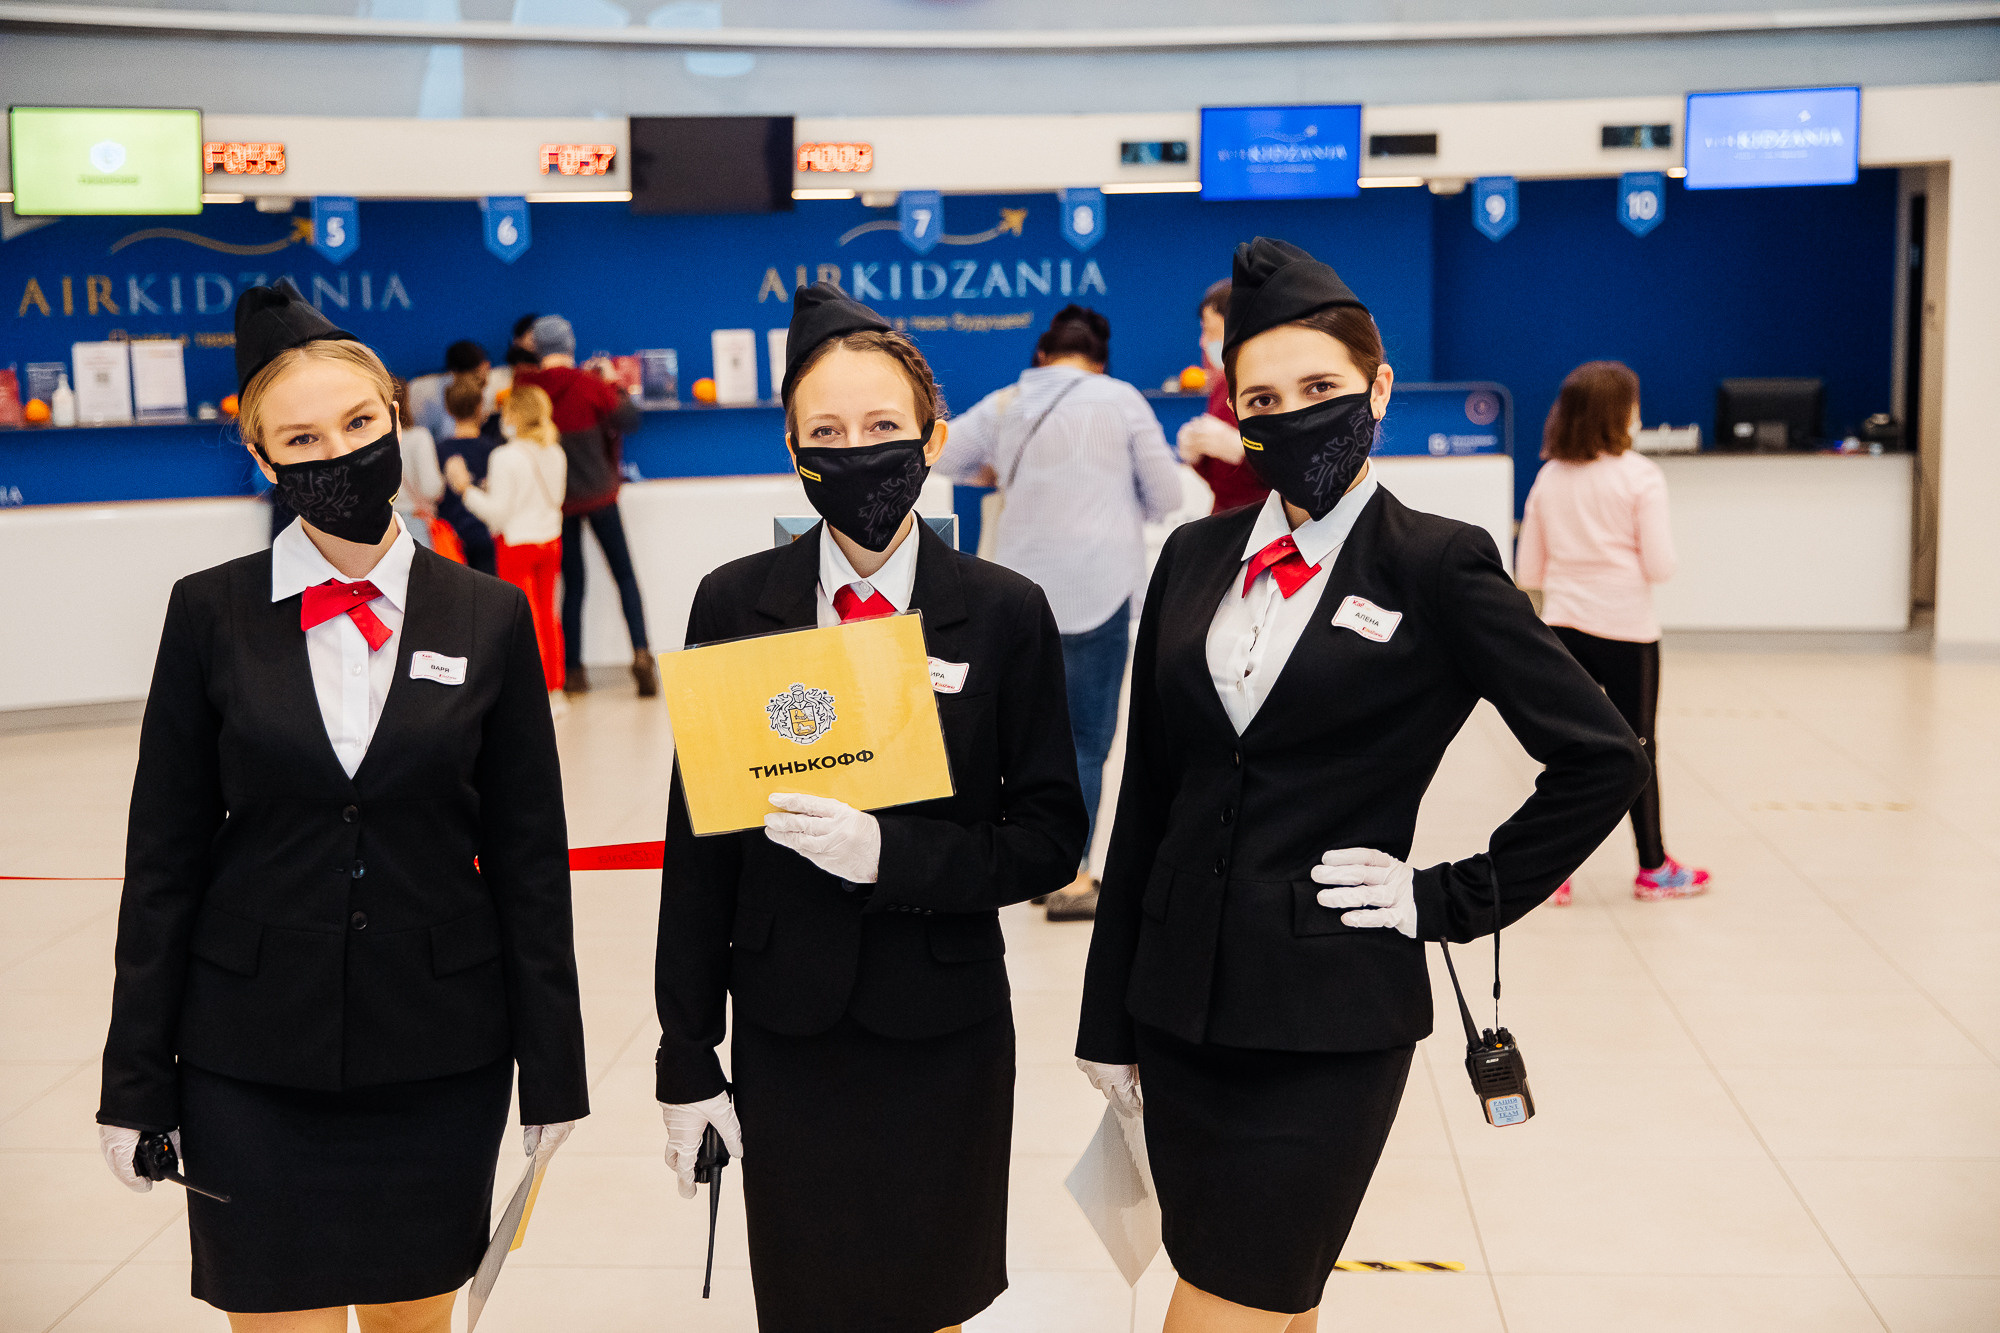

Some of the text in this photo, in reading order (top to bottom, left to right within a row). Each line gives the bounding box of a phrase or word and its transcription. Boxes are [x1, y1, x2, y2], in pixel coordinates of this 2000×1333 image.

[1073, 205, 1095, 235] 8
[1485, 194, 1507, 223] 9
[1626, 190, 1658, 220] 10
[326, 216, 346, 248] 5
[497, 215, 519, 246] 6
[911, 208, 932, 239] 7
[1355, 612, 1380, 626] АЛЕНА
[749, 749, 875, 780] ТИНЬКОФФ
[1499, 1110, 1519, 1118] TEAM
